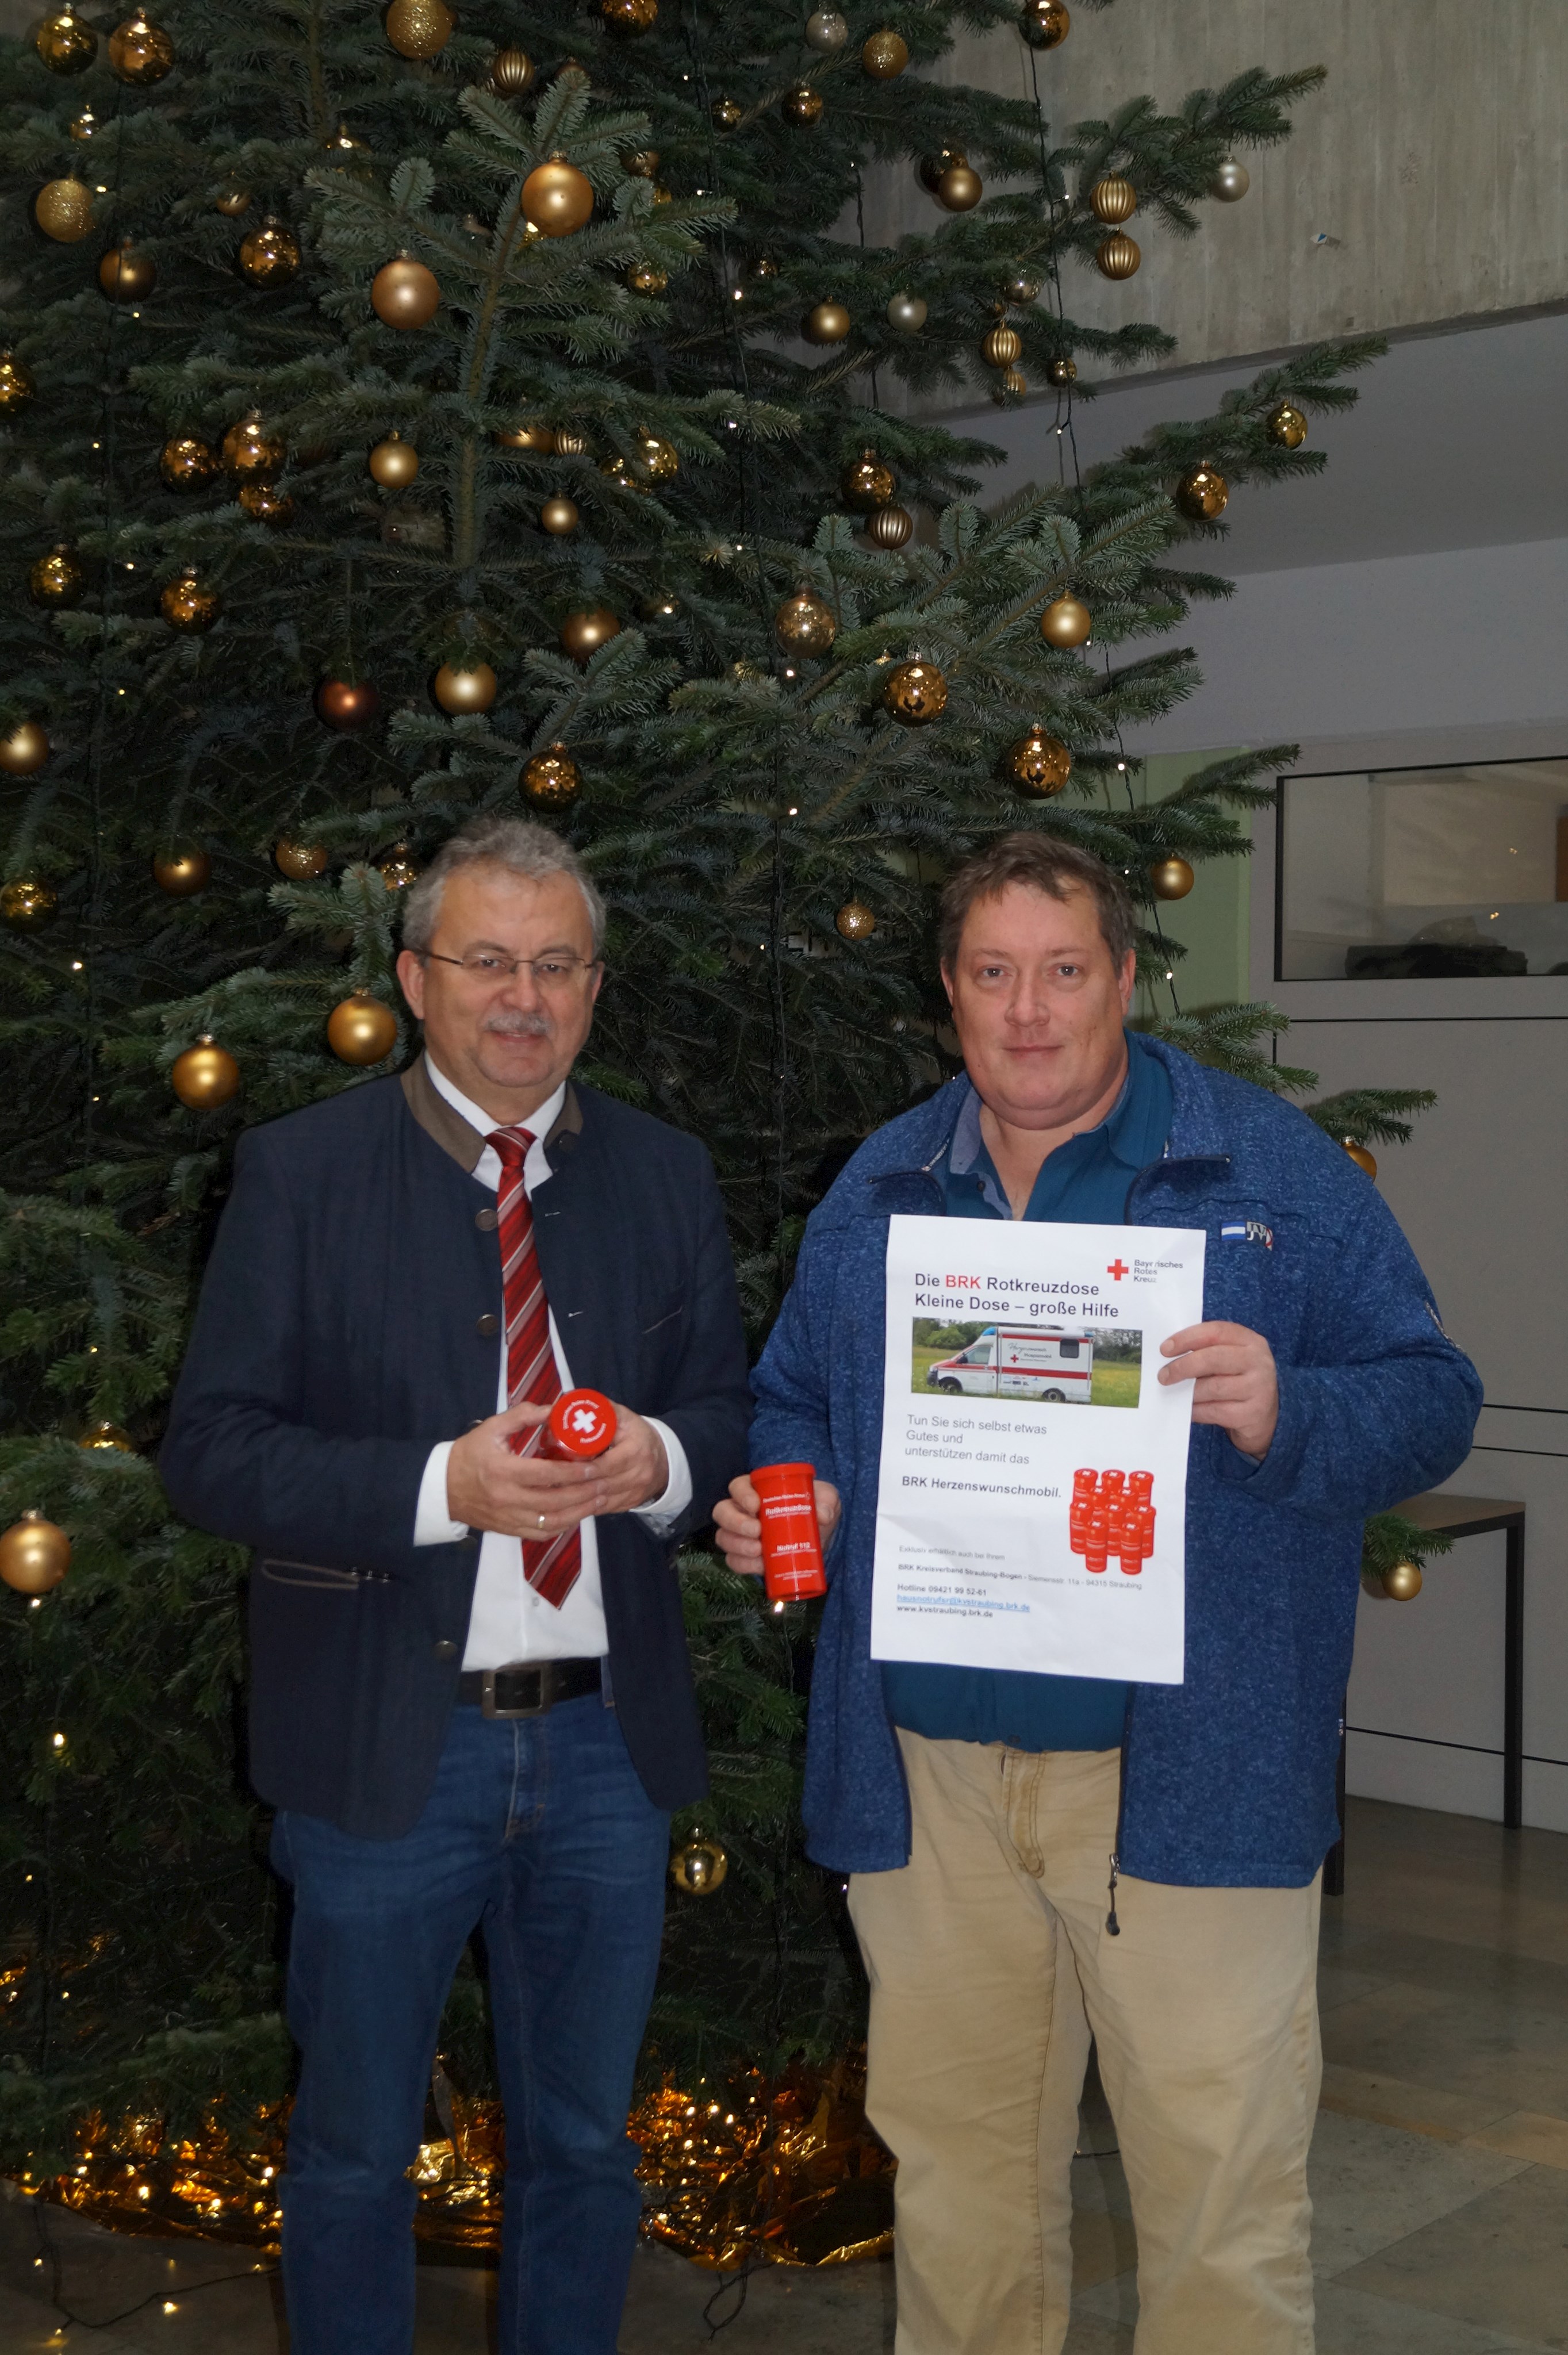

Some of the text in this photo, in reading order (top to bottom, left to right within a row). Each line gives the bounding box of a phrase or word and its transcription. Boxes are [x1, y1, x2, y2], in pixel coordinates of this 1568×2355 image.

[915, 1273, 1099, 1295] Die BRK Rotkreuzdose
[915, 1293, 964, 1309] Kleine
[969, 1297, 1010, 1311] Dose
[1029, 1302, 1077, 1317] große
[1082, 1303, 1119, 1318] Hilfe
[907, 1414, 1047, 1435] Tun Sie sich selbst etwas
[906, 1429, 963, 1444] Gutes und
[904, 1447, 1030, 1464] unterstützen damit das
[902, 1476, 1061, 1498] BRK Herzenswunschmobil.
[899, 1545, 927, 1554] Exklusiv
[897, 1583, 926, 1592] Hotline
[916, 1566, 964, 1574] Kreisverband
[965, 1568, 1022, 1580] Straubing-Bogen
[1109, 1581, 1142, 1590] Straubing
